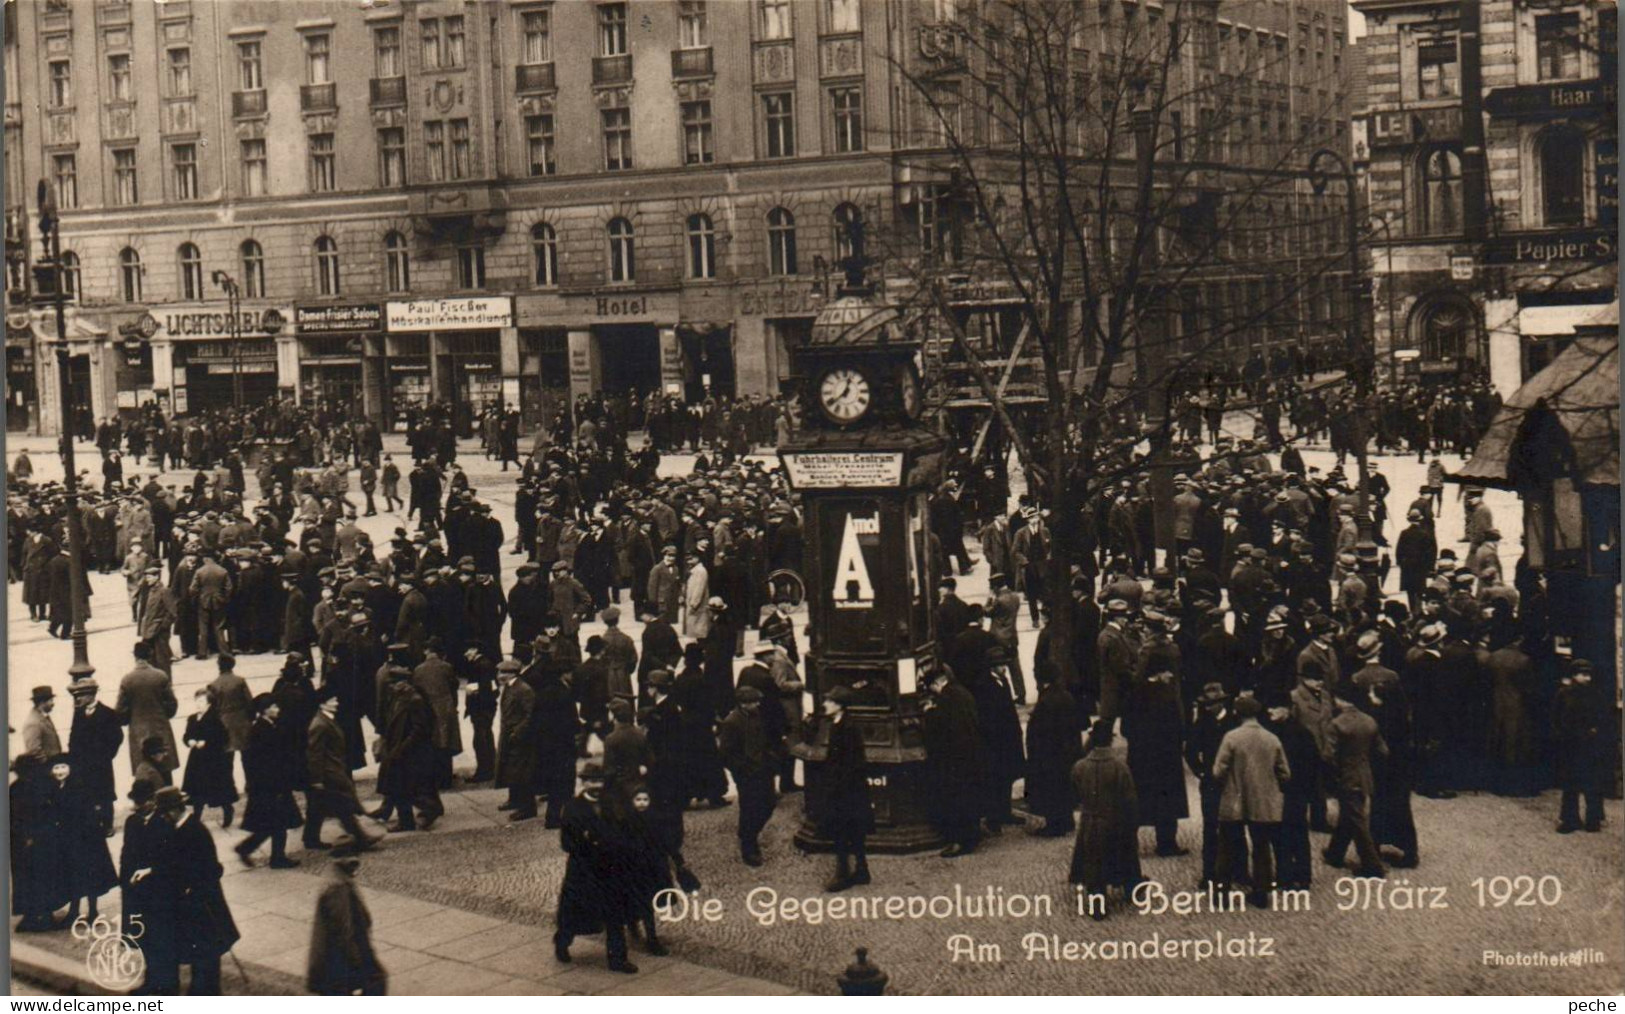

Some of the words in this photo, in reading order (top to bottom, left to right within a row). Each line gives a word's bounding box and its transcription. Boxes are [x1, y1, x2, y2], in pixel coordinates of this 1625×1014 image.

[1550, 87, 1594, 106] Haar
[1515, 239, 1589, 265] Papier
[407, 302, 435, 314] Paul
[596, 297, 648, 316] Hotel
